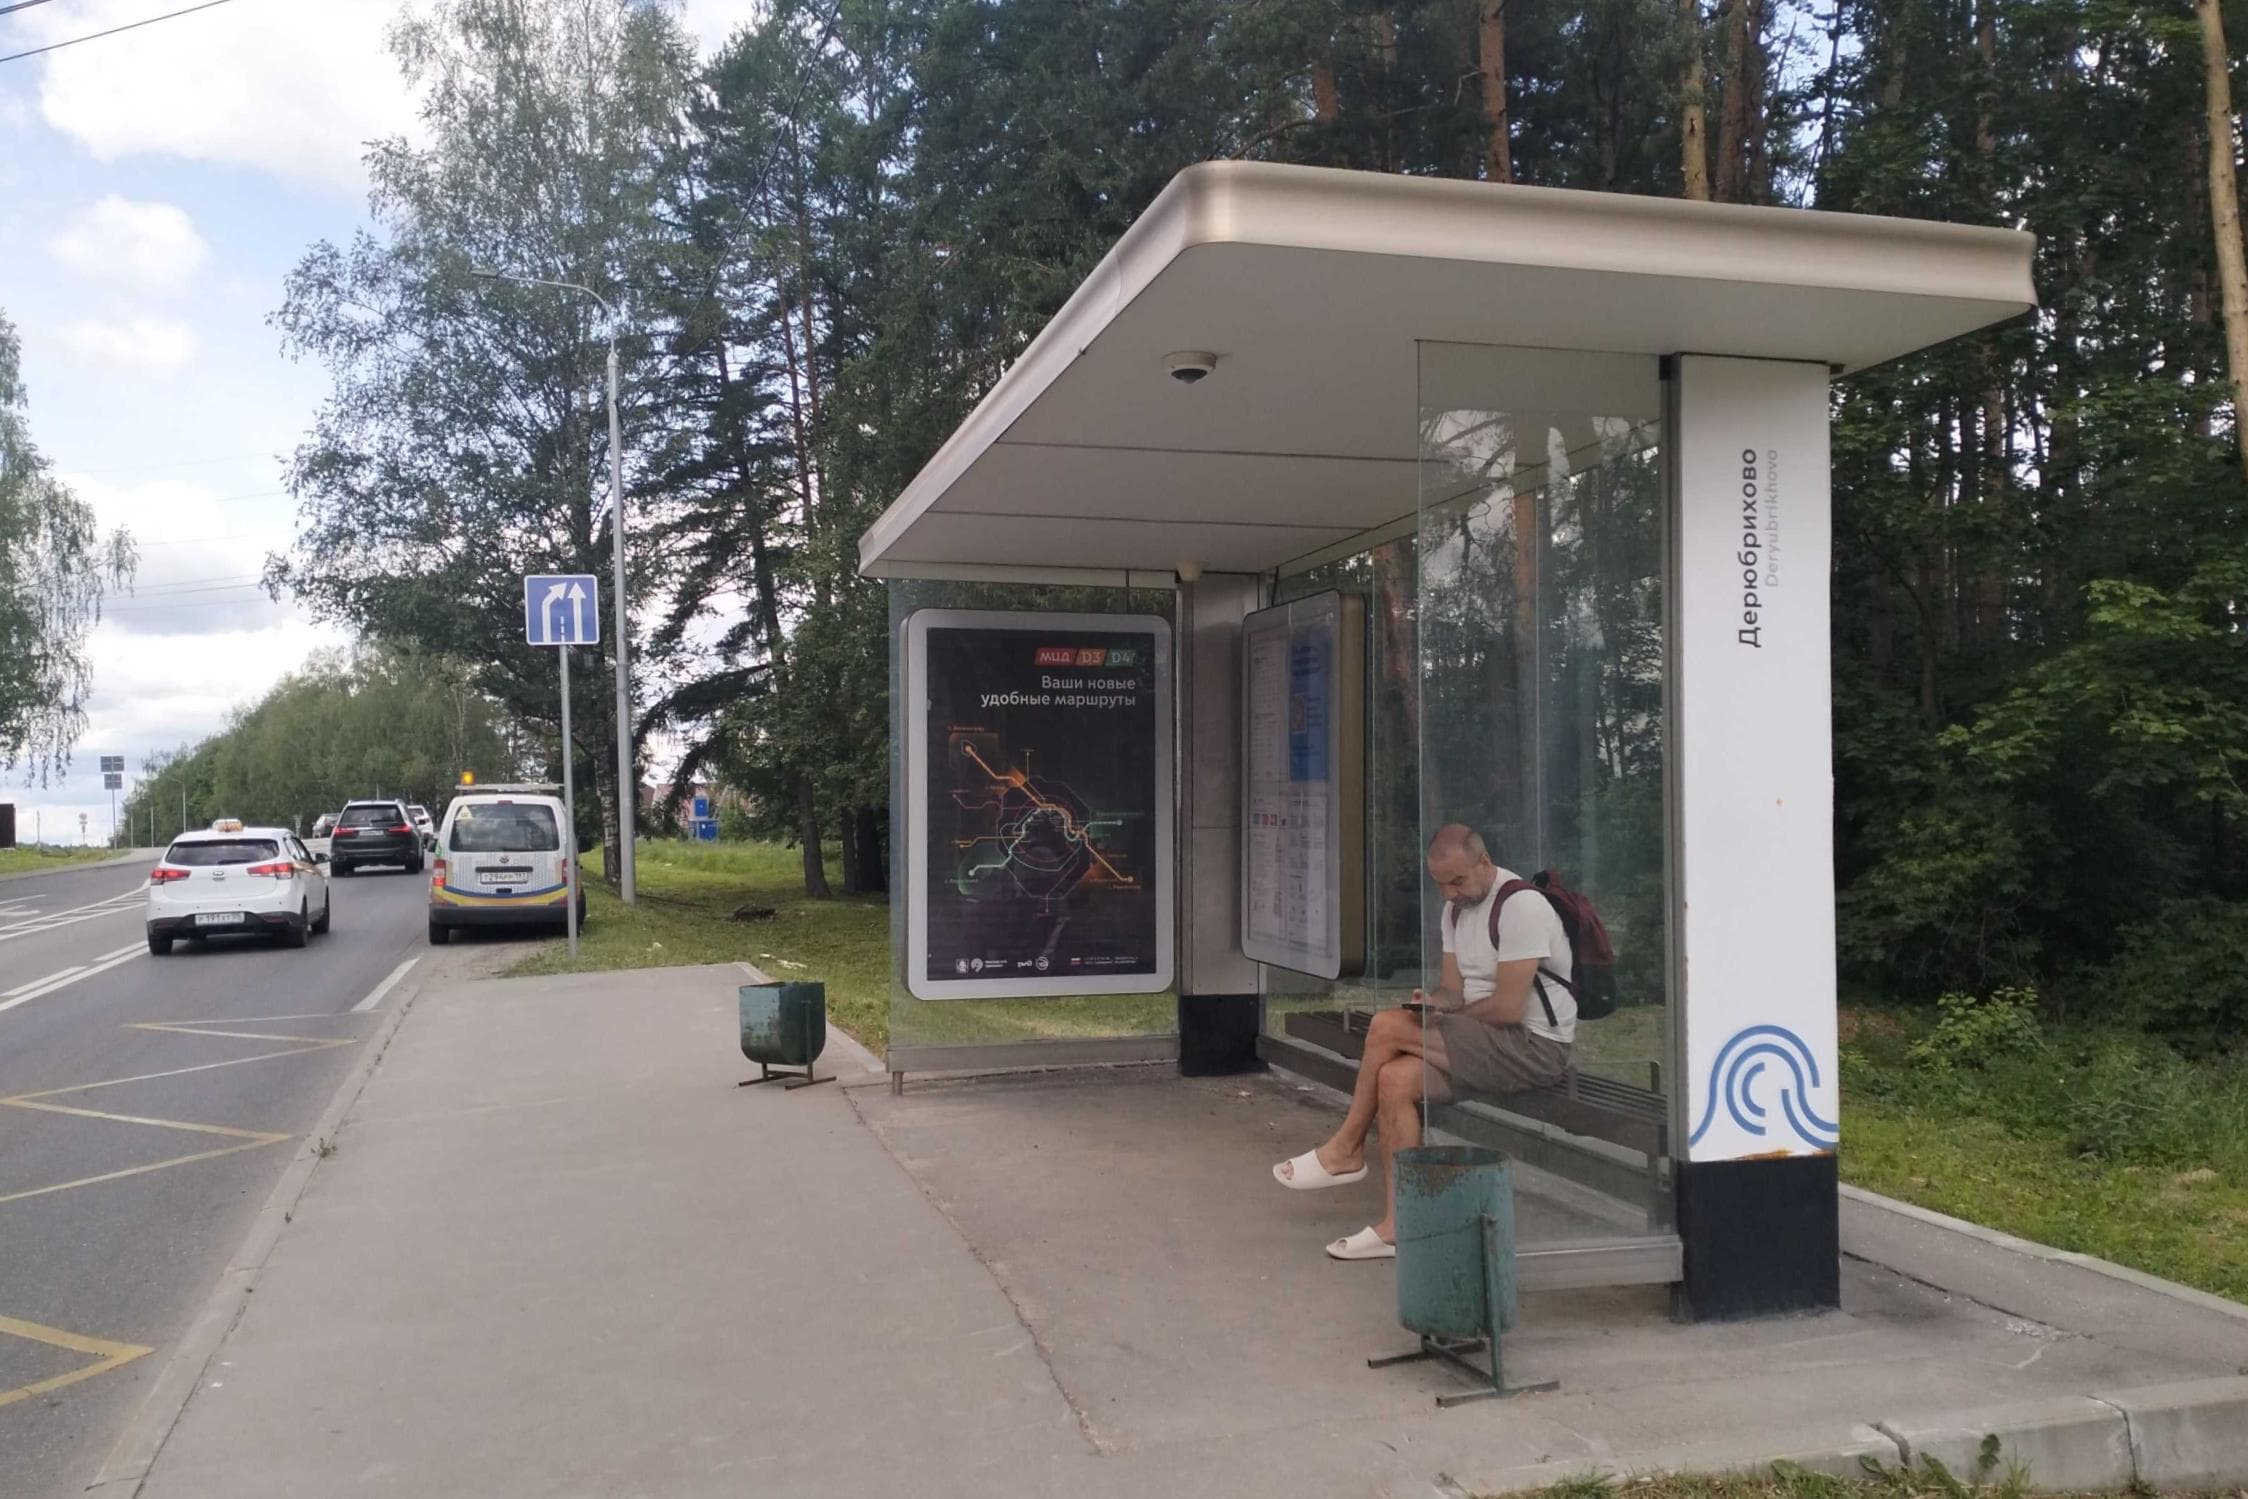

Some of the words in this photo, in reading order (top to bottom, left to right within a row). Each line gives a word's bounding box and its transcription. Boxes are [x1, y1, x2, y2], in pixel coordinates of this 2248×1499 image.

[1764, 449, 1780, 588] Deryubrikhovo
[1737, 449, 1762, 648] Дерюбрихово
[1040, 651, 1071, 662] МЦД
[1041, 675, 1083, 689] Ваши
[1088, 679, 1136, 690] новые
[980, 691, 1051, 708] удобные
[1054, 694, 1136, 709] маршруты
